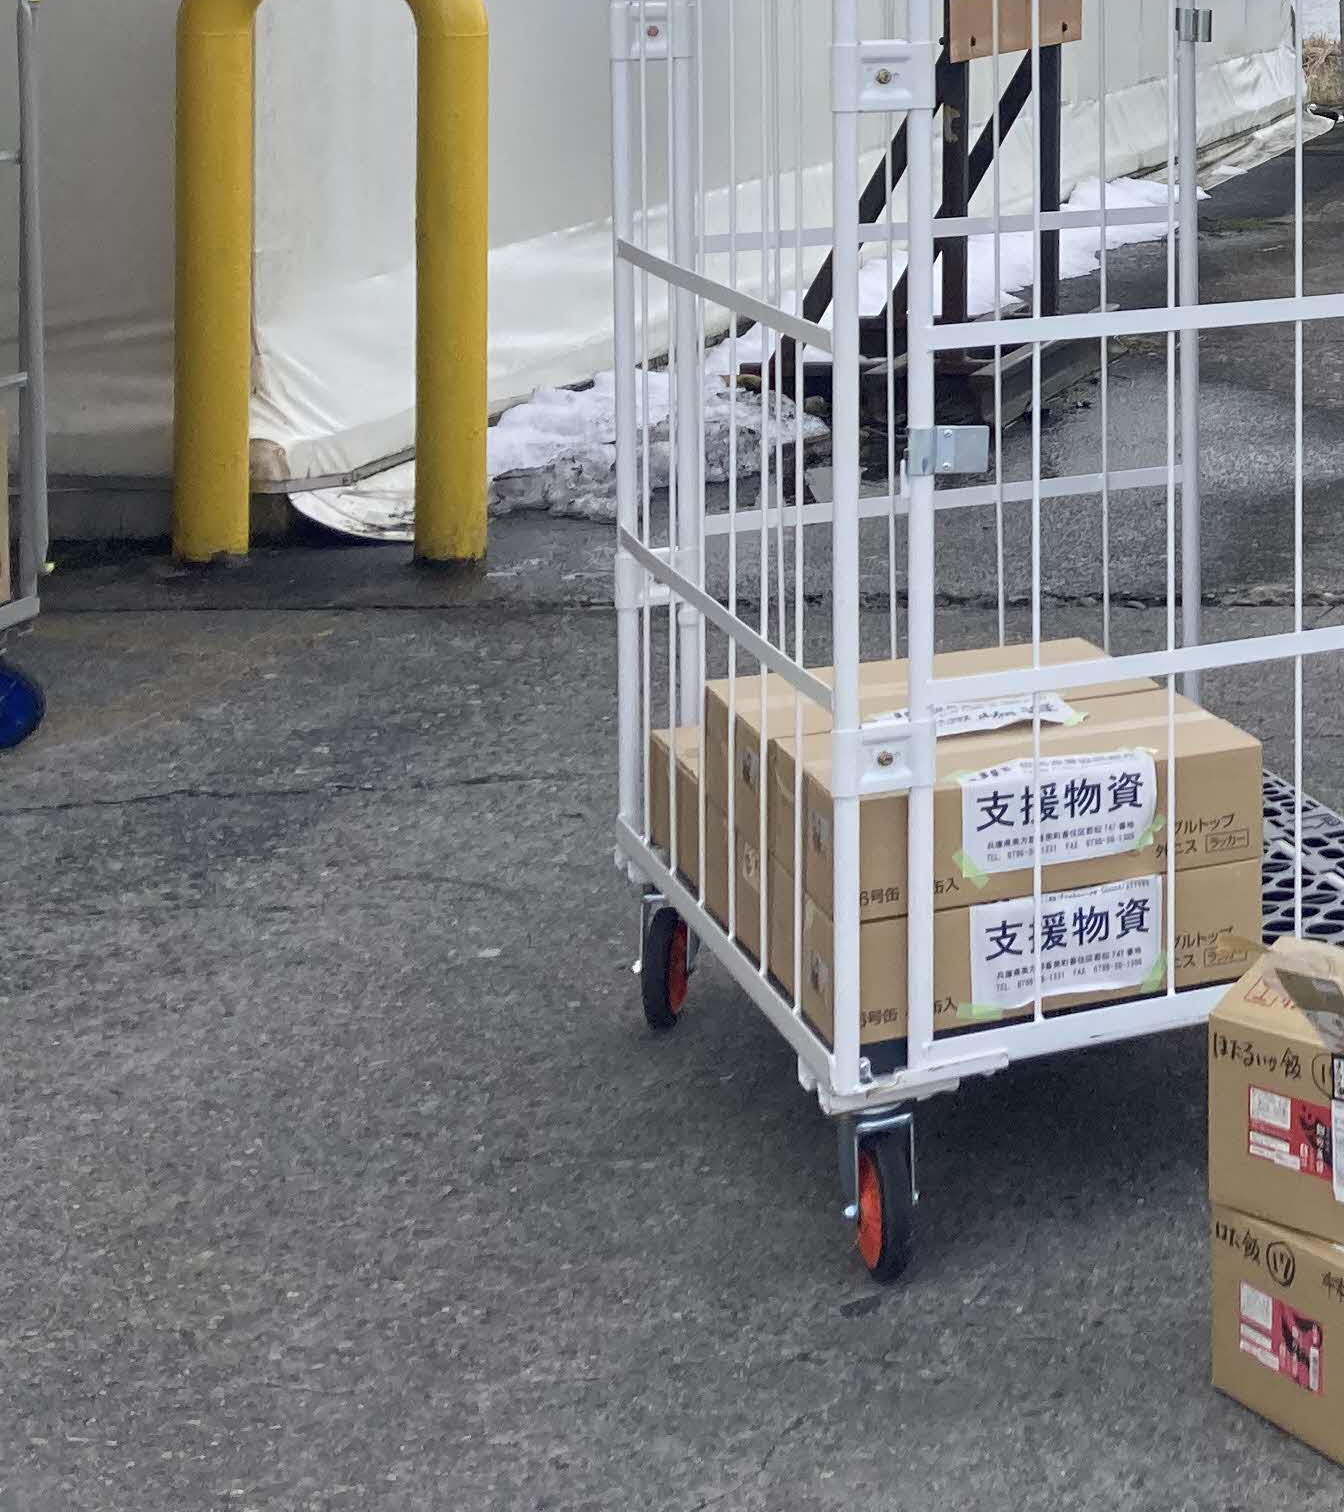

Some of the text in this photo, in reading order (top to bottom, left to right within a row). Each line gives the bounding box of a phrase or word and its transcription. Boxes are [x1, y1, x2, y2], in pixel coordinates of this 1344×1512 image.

[976, 772, 1144, 832] 支援物資
[985, 898, 1150, 961] 支援物資
